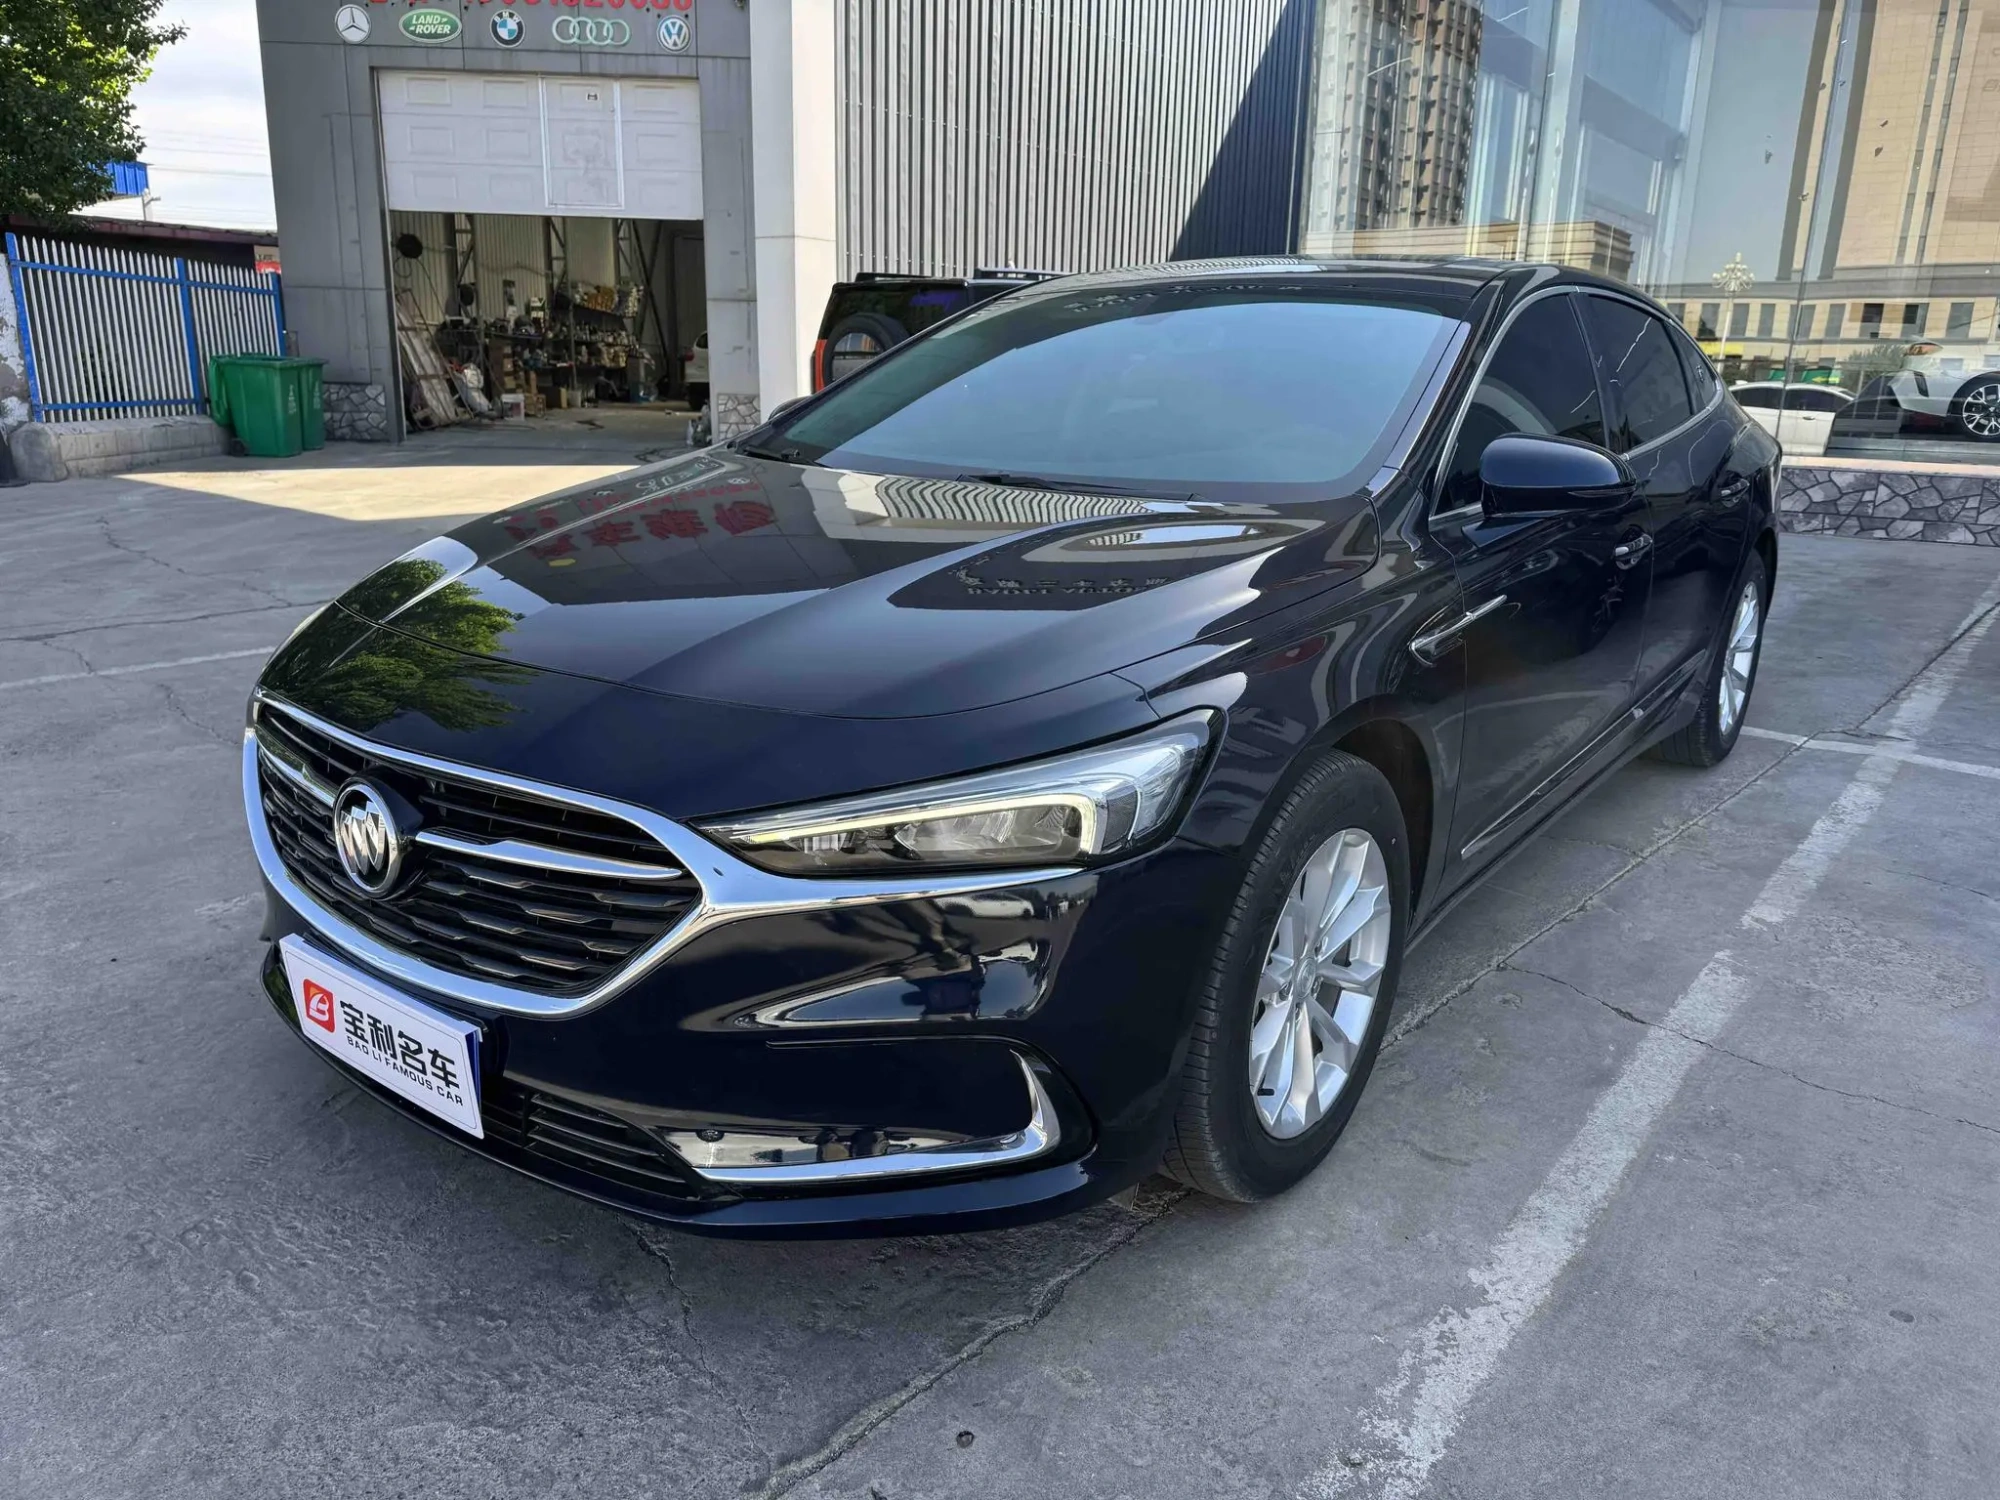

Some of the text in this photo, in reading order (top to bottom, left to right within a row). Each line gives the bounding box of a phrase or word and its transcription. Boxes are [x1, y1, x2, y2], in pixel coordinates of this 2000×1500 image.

[412, 14, 441, 24] LAND
[415, 24, 451, 34] ROVER
[340, 1000, 460, 1089] 宝利名车
[347, 1035, 464, 1107] BAO LI FAMOUS CAR
